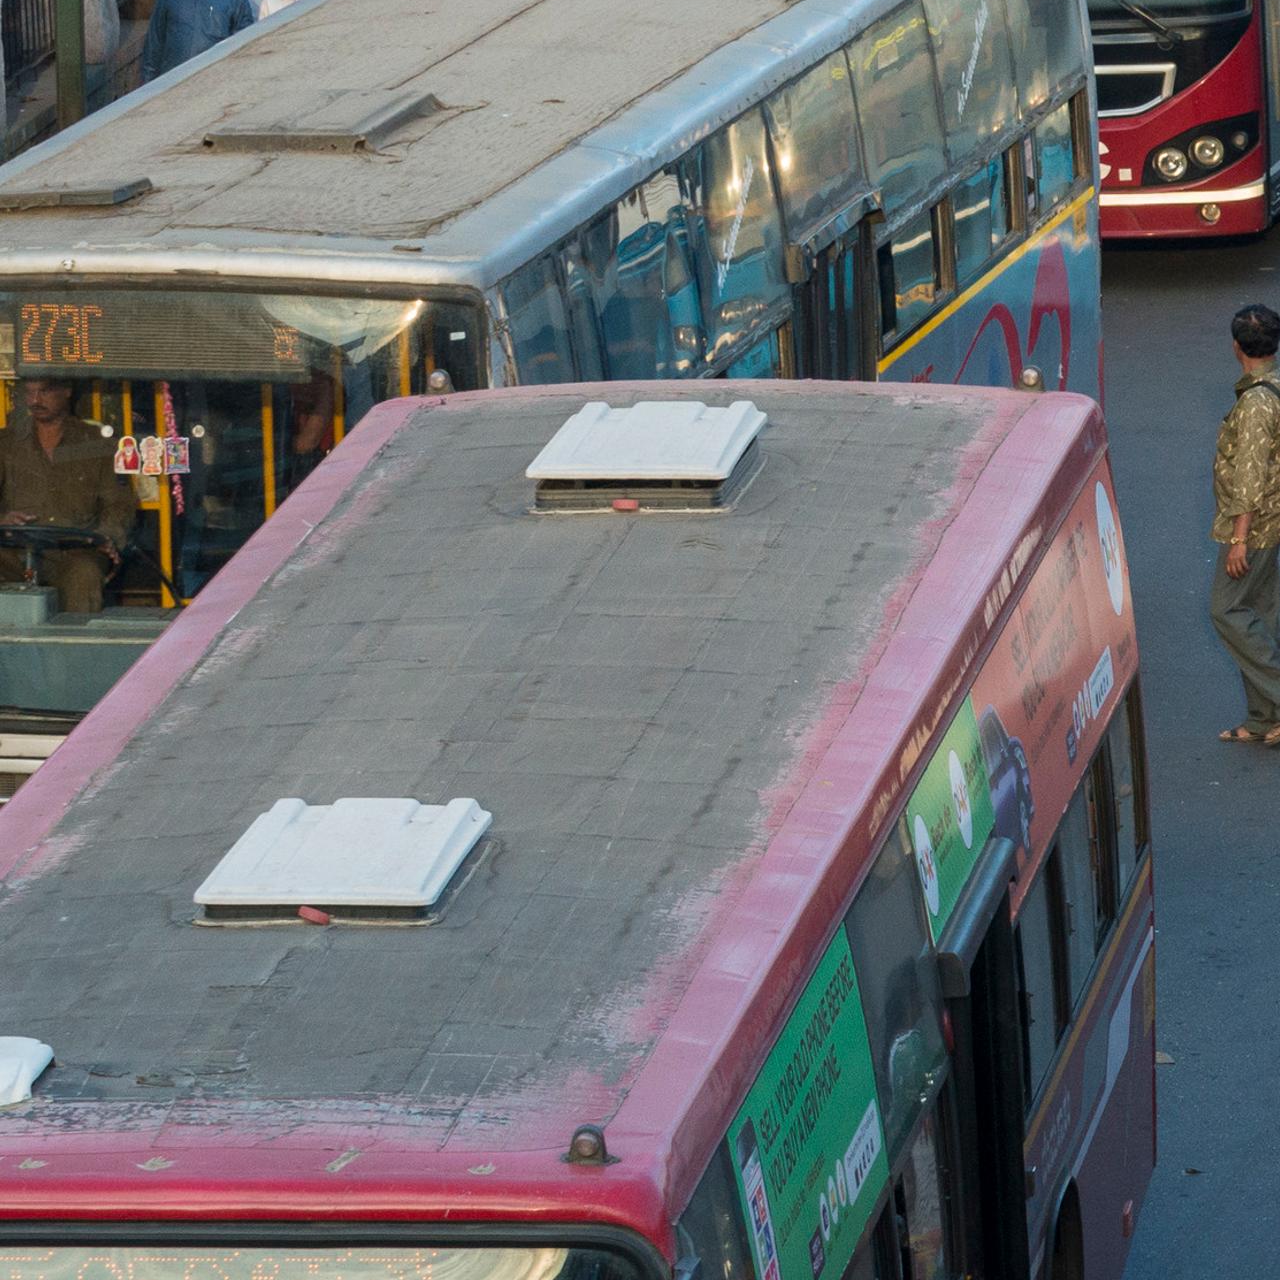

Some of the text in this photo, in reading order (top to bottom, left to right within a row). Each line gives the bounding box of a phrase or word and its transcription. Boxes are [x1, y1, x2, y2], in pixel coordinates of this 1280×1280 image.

[20, 303, 104, 365] 273C
[758, 1100, 781, 1153] SELL
[774, 1065, 797, 1120] YOUR
[804, 1002, 831, 1063] PHONE
[824, 955, 854, 1023] BEFORE
[813, 1044, 842, 1109] PHONE
